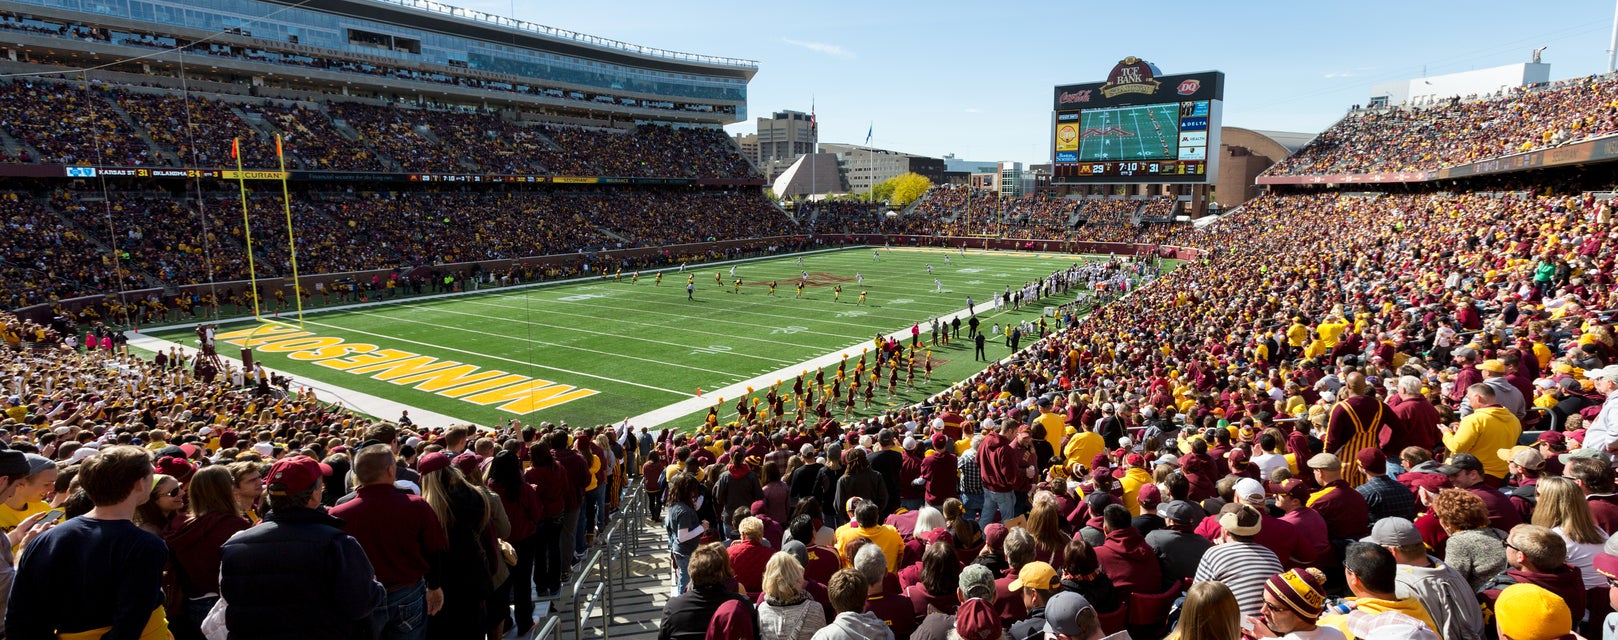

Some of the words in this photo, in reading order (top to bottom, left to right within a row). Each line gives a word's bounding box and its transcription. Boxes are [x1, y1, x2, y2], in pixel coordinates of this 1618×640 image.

[1121, 66, 1140, 76] TCF
[1117, 74, 1143, 85] BANK
[1182, 83, 1197, 92] DQ
[1059, 90, 1092, 104] Coca-Cola
[1092, 164, 1104, 174] 29
[1119, 162, 1138, 171] 7:10
[1149, 163, 1159, 173] 31
[137, 169, 149, 177] 31
[188, 170, 201, 178] 24
[212, 170, 219, 178] 3
[232, 171, 281, 179] SCURIAN
[214, 324, 601, 415] MINNESOTA
